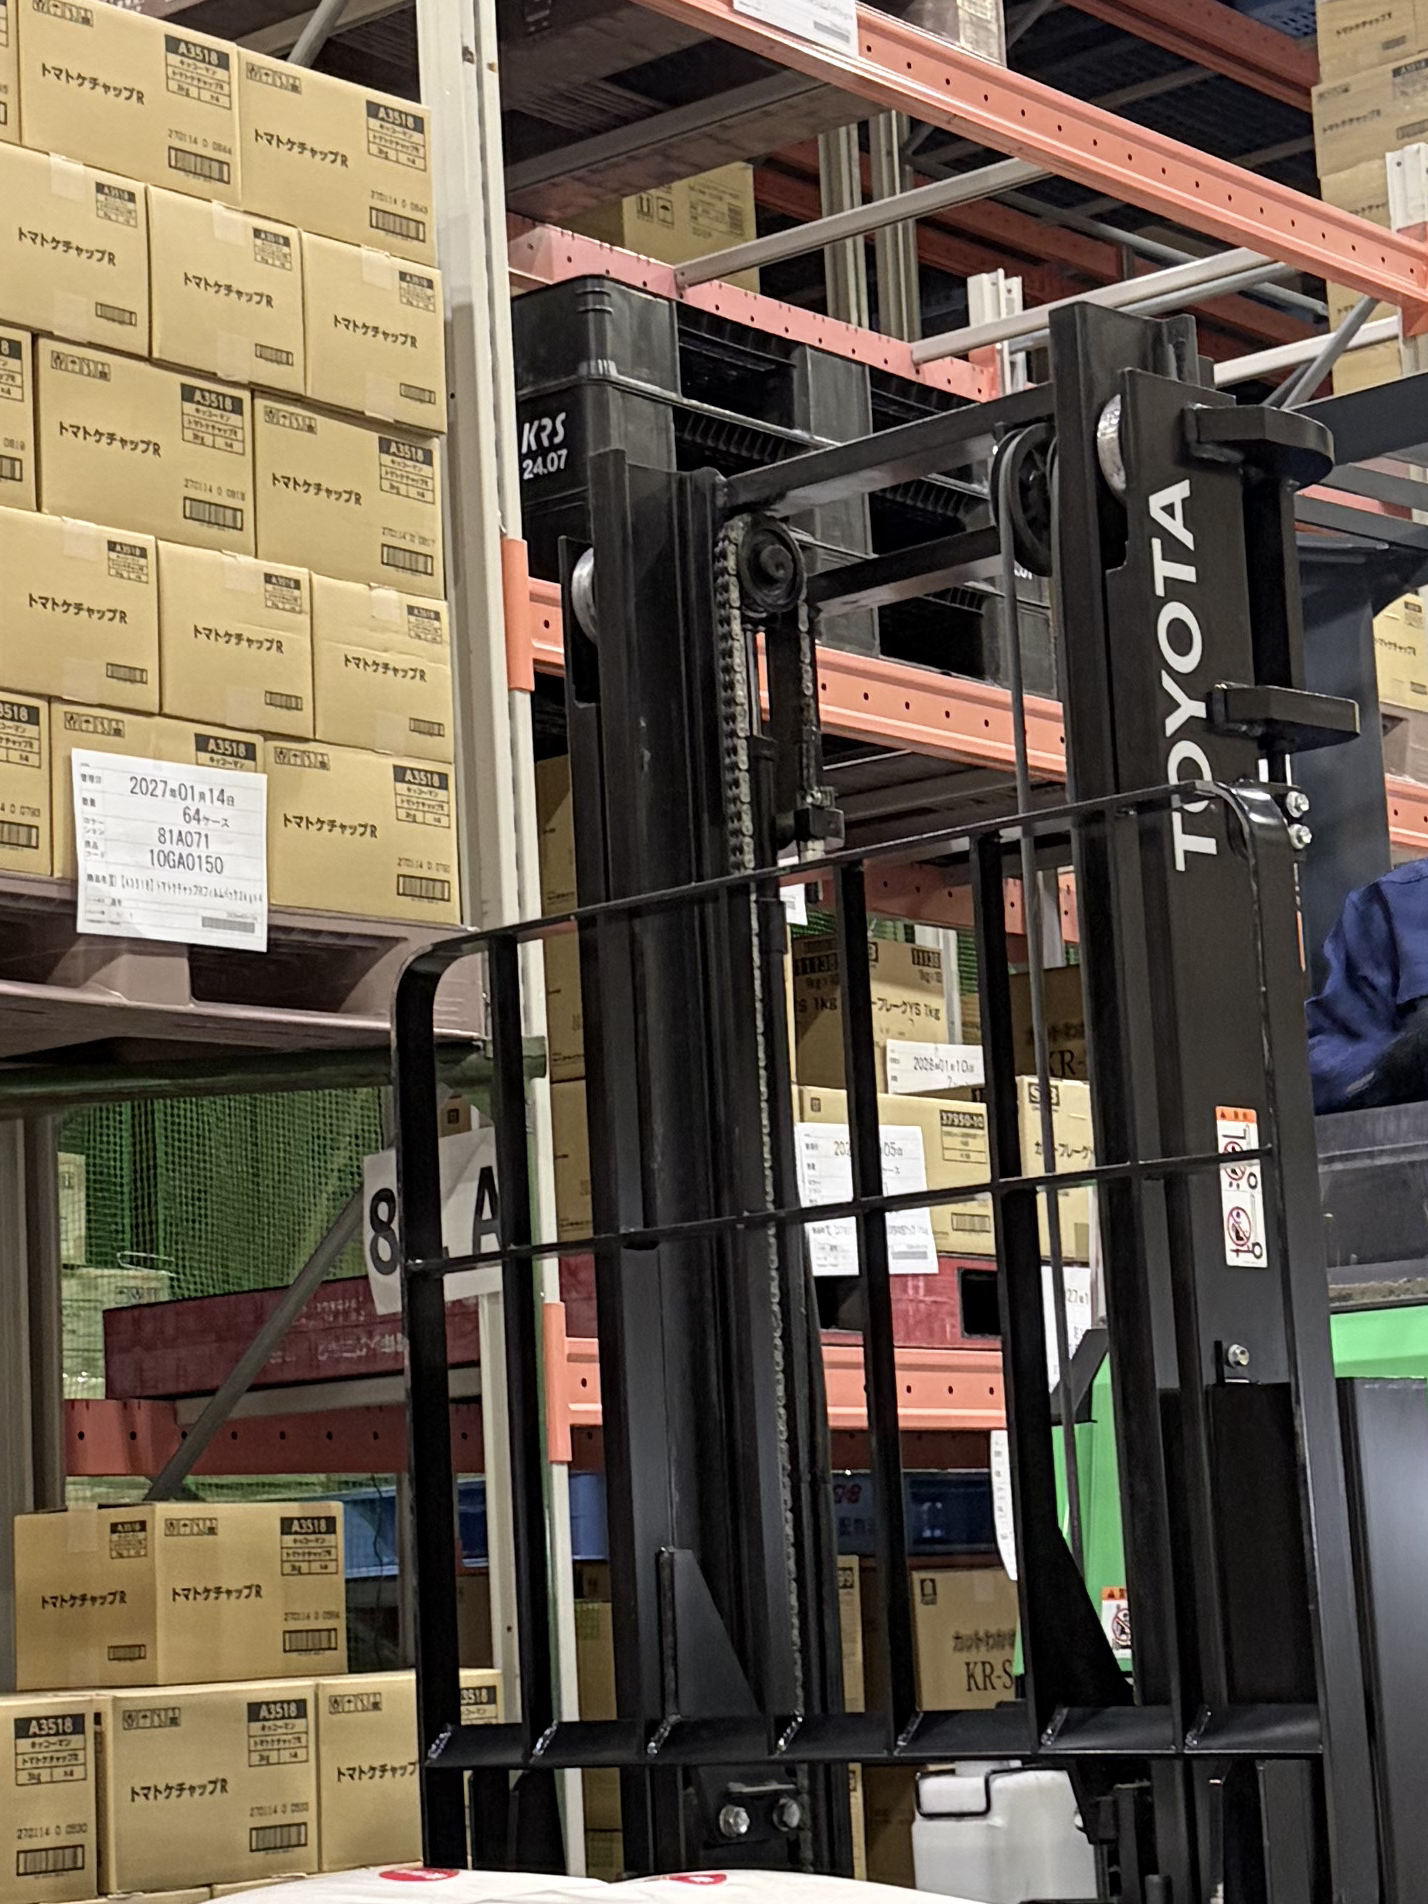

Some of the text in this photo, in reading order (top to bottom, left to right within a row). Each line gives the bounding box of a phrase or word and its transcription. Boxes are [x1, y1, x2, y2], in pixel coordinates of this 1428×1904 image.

[42, 63, 144, 105] トマトケチャップR
[378, 106, 414, 128] A3518
[255, 129, 348, 168] トマトケチャップR
[59, 421, 161, 457] トマトケチャップR
[521, 412, 566, 454] KRS
[389, 439, 424, 462] A3518
[522, 449, 568, 481] 24.07
[272, 473, 361, 505] トマトケチャップR
[29, 593, 127, 624] トマトケチャップR
[194, 625, 283, 654] トマトケチャップR
[344, 654, 426, 682] トマトケチャップR
[1147, 478, 1218, 872] TOYOTA
[207, 739, 246, 757] A3518
[129, 776, 235, 807] 2027年01月14日
[182, 806, 230, 828] 64ケース
[284, 813, 377, 838] トマトケチャップR
[158, 827, 209, 849] 81A071
[149, 849, 224, 874] 10GA0150
[42, 1590, 127, 1609] トマトケチャップR
[172, 1584, 262, 1602] トマトケチャップR
[259, 1701, 297, 1718] A3518
[337, 1759, 418, 1783] トマトケチャップ
[131, 1778, 228, 1802] トマトケチャップR
